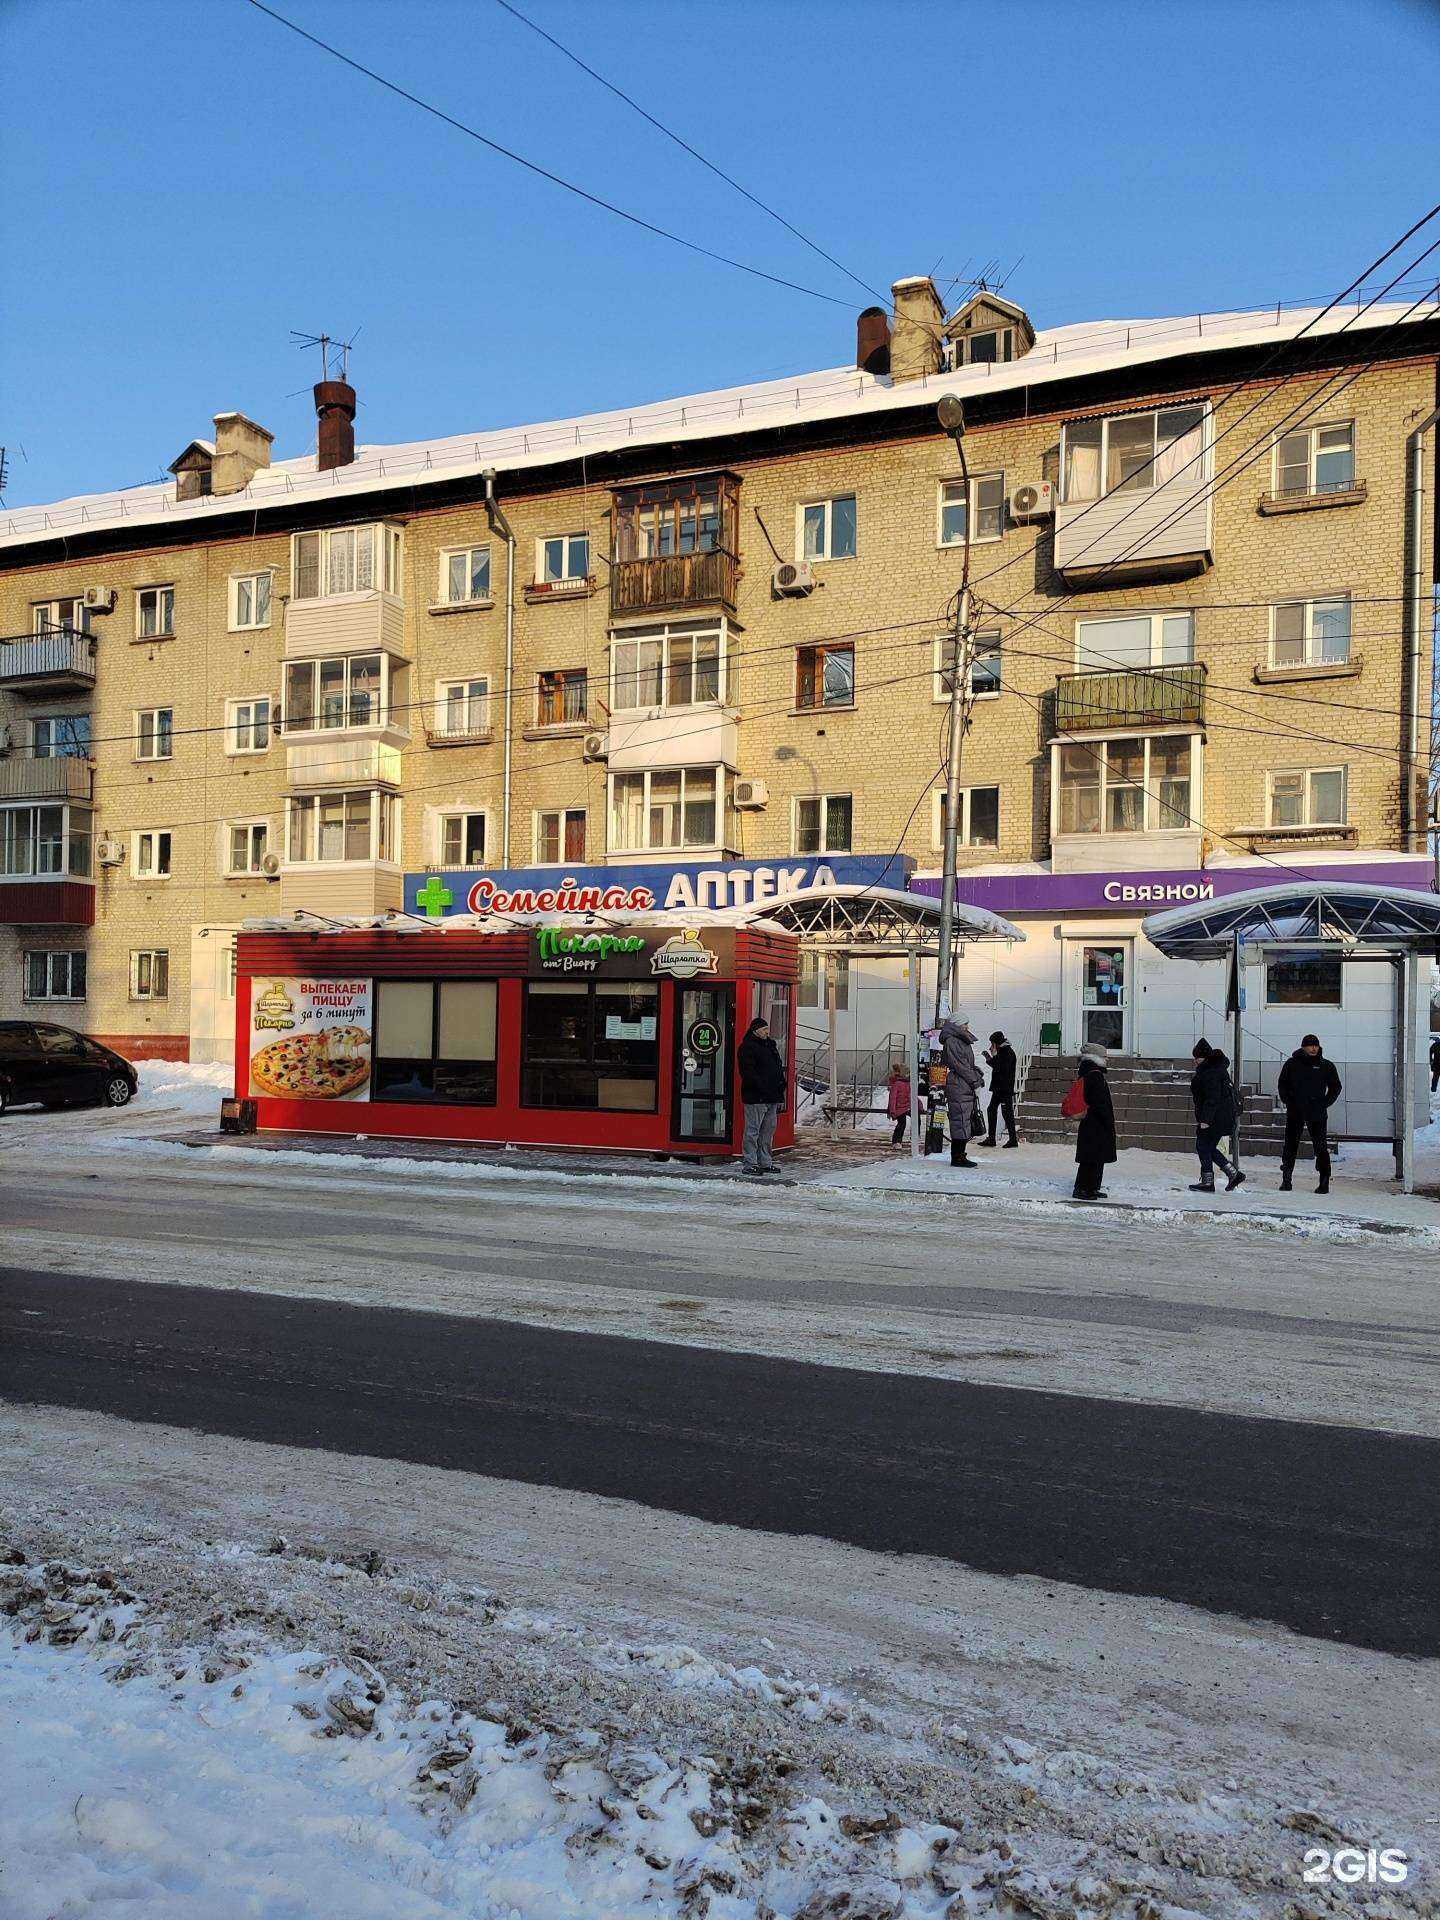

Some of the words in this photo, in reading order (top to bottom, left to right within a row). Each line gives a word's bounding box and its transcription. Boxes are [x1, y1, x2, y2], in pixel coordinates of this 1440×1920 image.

[468, 878, 655, 914] Семейная
[664, 864, 837, 908] АПТЕКА
[1103, 874, 1214, 901] Связной
[536, 928, 646, 960] Пекарня
[660, 954, 708, 966] Шарлотка
[300, 983, 367, 994] ВЫПЕКАЕМ
[312, 995, 354, 1008] ПИЦЦУ
[300, 1011, 313, 1024] за
[315, 1007, 323, 1019] 6
[325, 1006, 366, 1023] минут
